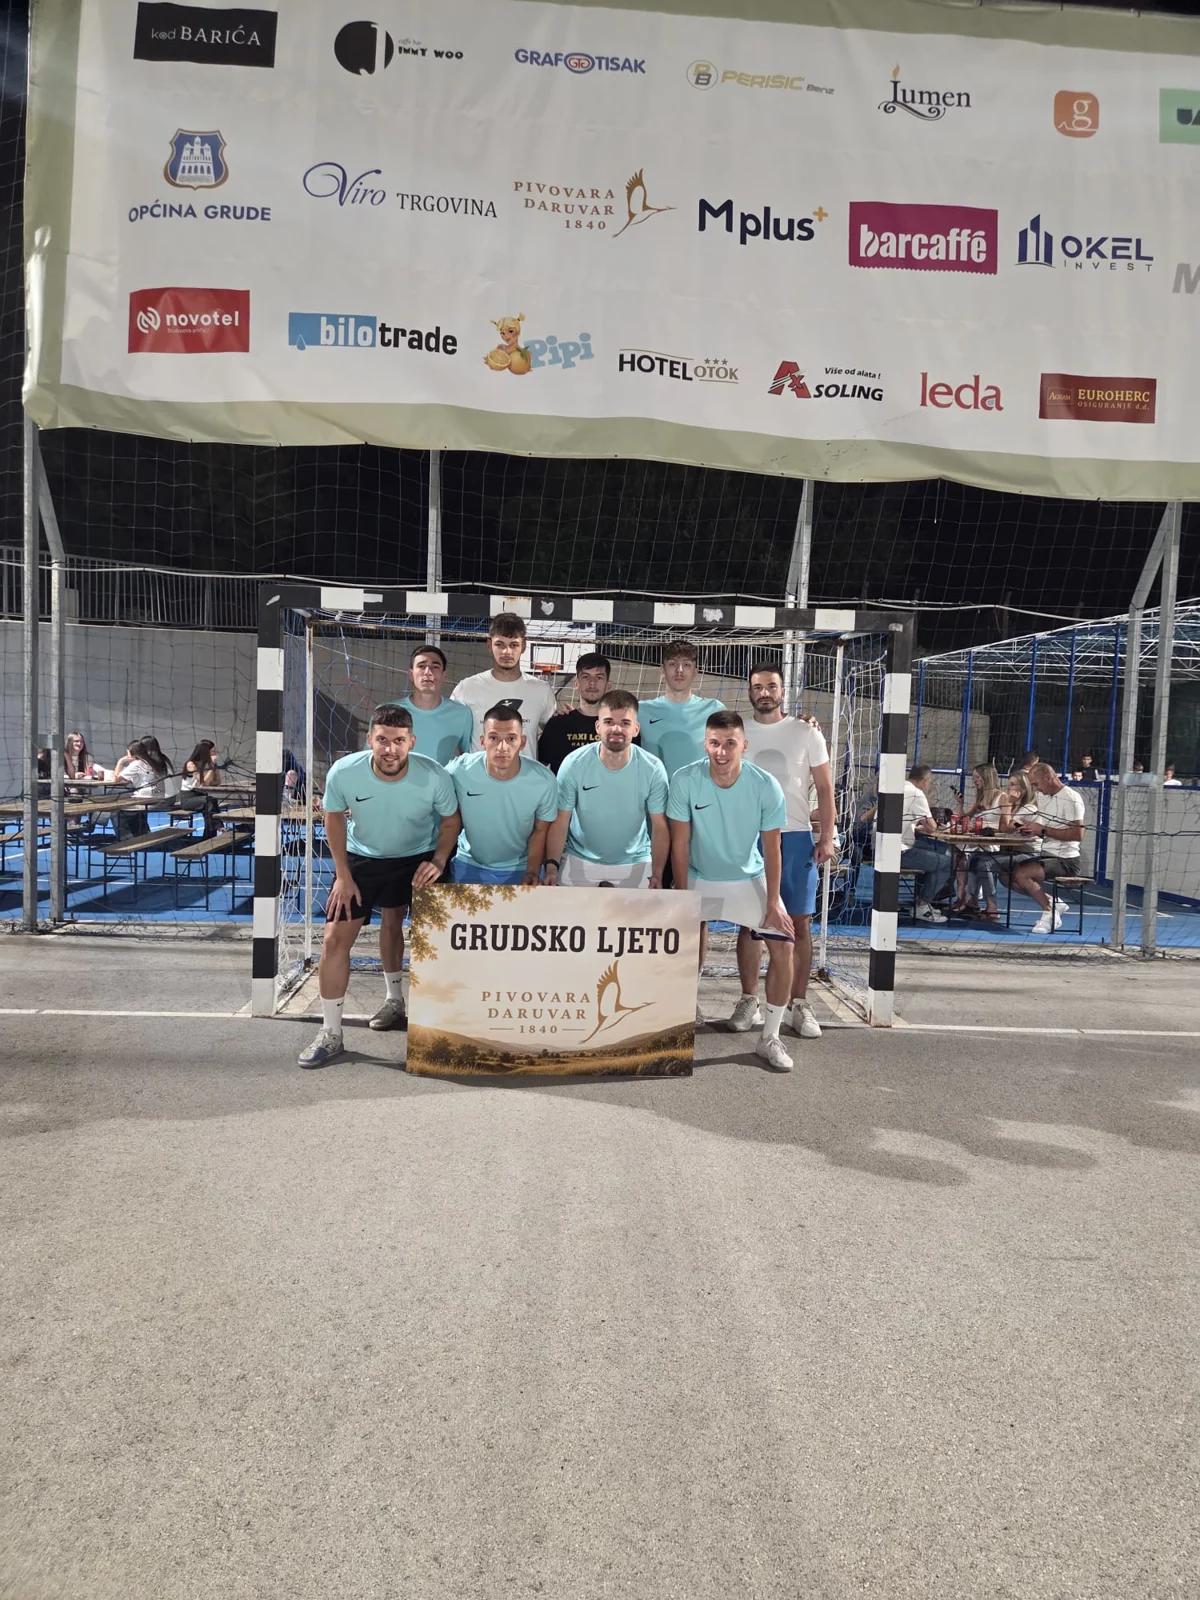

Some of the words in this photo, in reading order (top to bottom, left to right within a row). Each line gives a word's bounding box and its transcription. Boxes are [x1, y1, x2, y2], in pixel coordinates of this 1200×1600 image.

[180, 24, 262, 46] BARIĆA
[433, 49, 464, 60] WOO
[806, 83, 835, 95] Benz
[878, 80, 972, 121] Lumen
[303, 162, 387, 207] Viro
[396, 192, 498, 219] TRGOVINA
[513, 181, 616, 200] PIVOVARA
[128, 199, 198, 223] OPĆINA
[203, 204, 272, 222] GRUDE
[524, 197, 615, 216] DARUVAR
[565, 219, 607, 230] 1840
[859, 223, 987, 263] barcaffé
[1061, 235, 1154, 262] OKEL
[1063, 260, 1154, 272] INVEST
[165, 310, 239, 326] novotel
[525, 332, 595, 370] Pipi
[618, 353, 694, 381] HOTEL
[693, 365, 739, 381] OTOK
[844, 368, 856, 376] od
[857, 370, 876, 379] alata
[813, 384, 884, 402] SOLING
[919, 371, 1004, 412] leda
[1077, 388, 1150, 403] EUROHERC
[1077, 400, 1132, 410] OSIGURANJE
[566, 733, 587, 741] TAXI
[450, 923, 586, 953] GRUDSKO
[596, 926, 680, 958] LJETO
[481, 991, 591, 1004] PIVOVARA
[487, 1007, 587, 1020] DARUVAR
[519, 1024, 558, 1034] 1840
